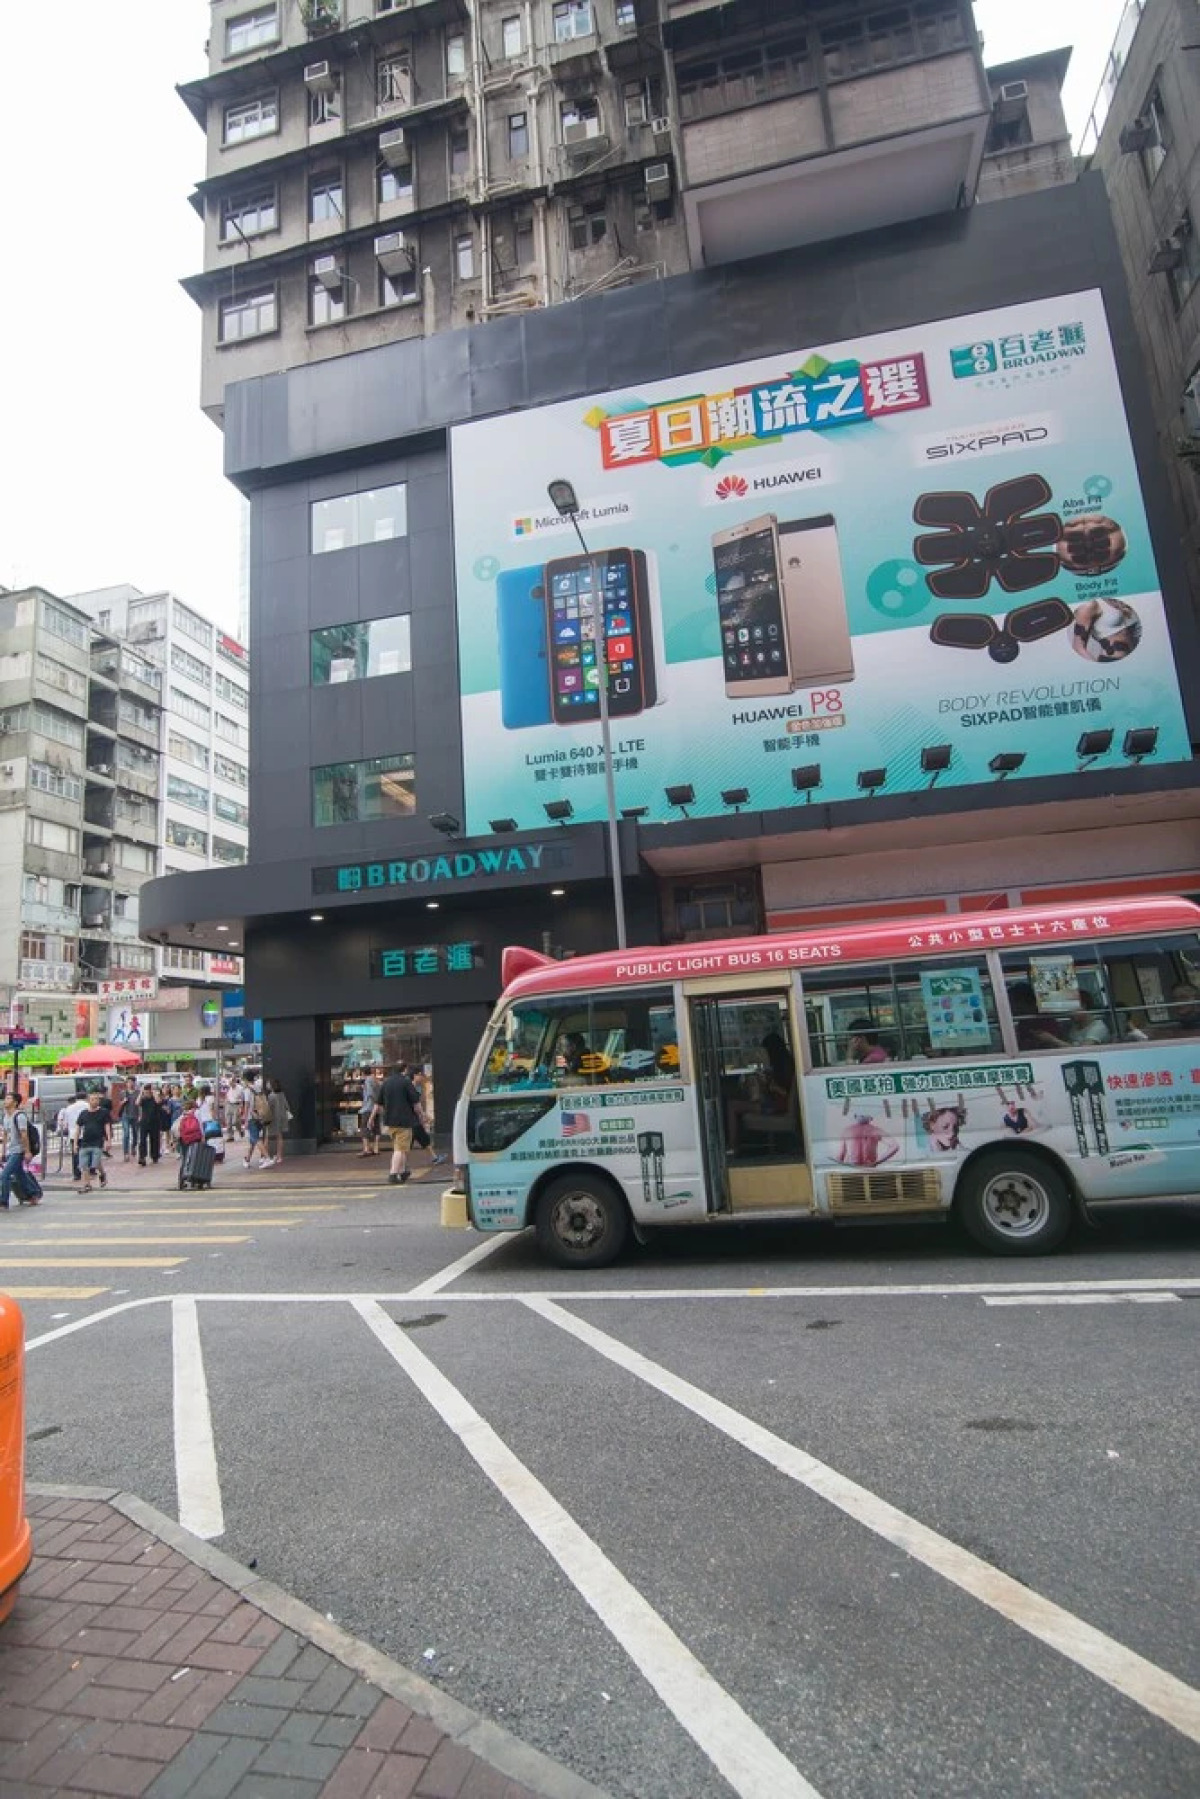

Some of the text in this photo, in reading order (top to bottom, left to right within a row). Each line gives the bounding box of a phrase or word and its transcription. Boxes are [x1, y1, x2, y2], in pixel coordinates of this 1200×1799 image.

[1002, 344, 1087, 371] BROADWAY
[605, 360, 922, 462] 夏日潮流之選
[926, 427, 1048, 460] SIXPAD
[753, 467, 822, 490] HUAWEI
[593, 502, 629, 519] Lumia
[1062, 498, 1086, 507] Abs
[1075, 582, 1101, 591] Body
[732, 704, 803, 726] HUAWEI
[810, 689, 843, 714] P8
[938, 677, 1121, 714] BODY REVOLUTION
[525, 738, 645, 766] Lumia 640 X LTE
[762, 733, 821, 753] 智能手機
[367, 844, 545, 886] BROADWAY
[908, 915, 1110, 947] 公共小型巴士十六座位
[616, 944, 841, 977] PUBLIC LIGHT BUS 16 SEATS
